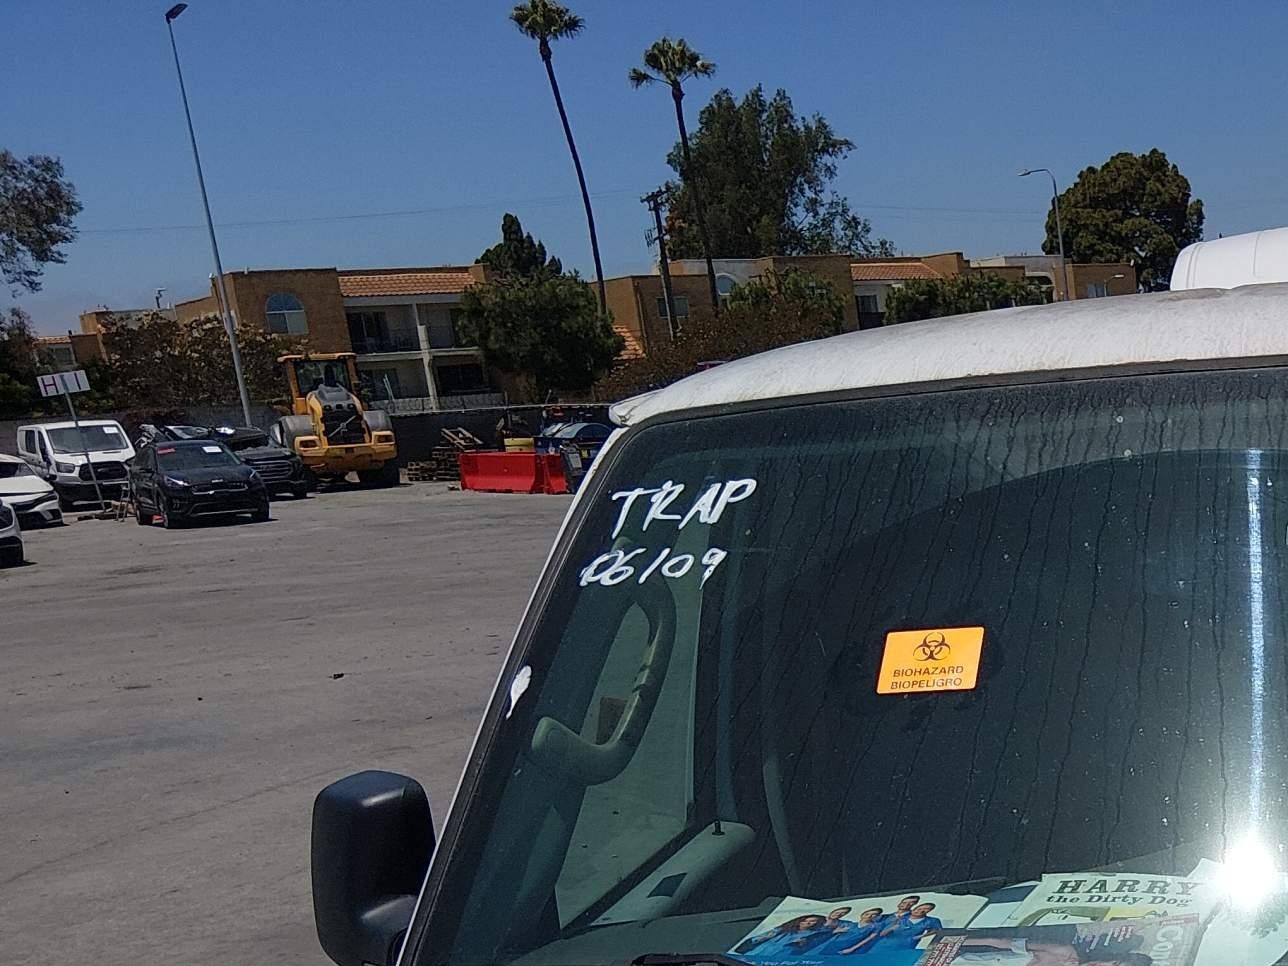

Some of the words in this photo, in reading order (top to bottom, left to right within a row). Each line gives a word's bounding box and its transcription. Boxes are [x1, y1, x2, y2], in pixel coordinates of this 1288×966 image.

[611, 479, 757, 539] TRAP
[893, 665, 964, 678] BIOHAZARD
[890, 677, 963, 690] BIOPELIGRO
[1052, 879, 1203, 896] HARRY
[1046, 894, 1081, 904] the
[1086, 894, 1145, 906] Dirty
[1146, 895, 1194, 908] Dog
